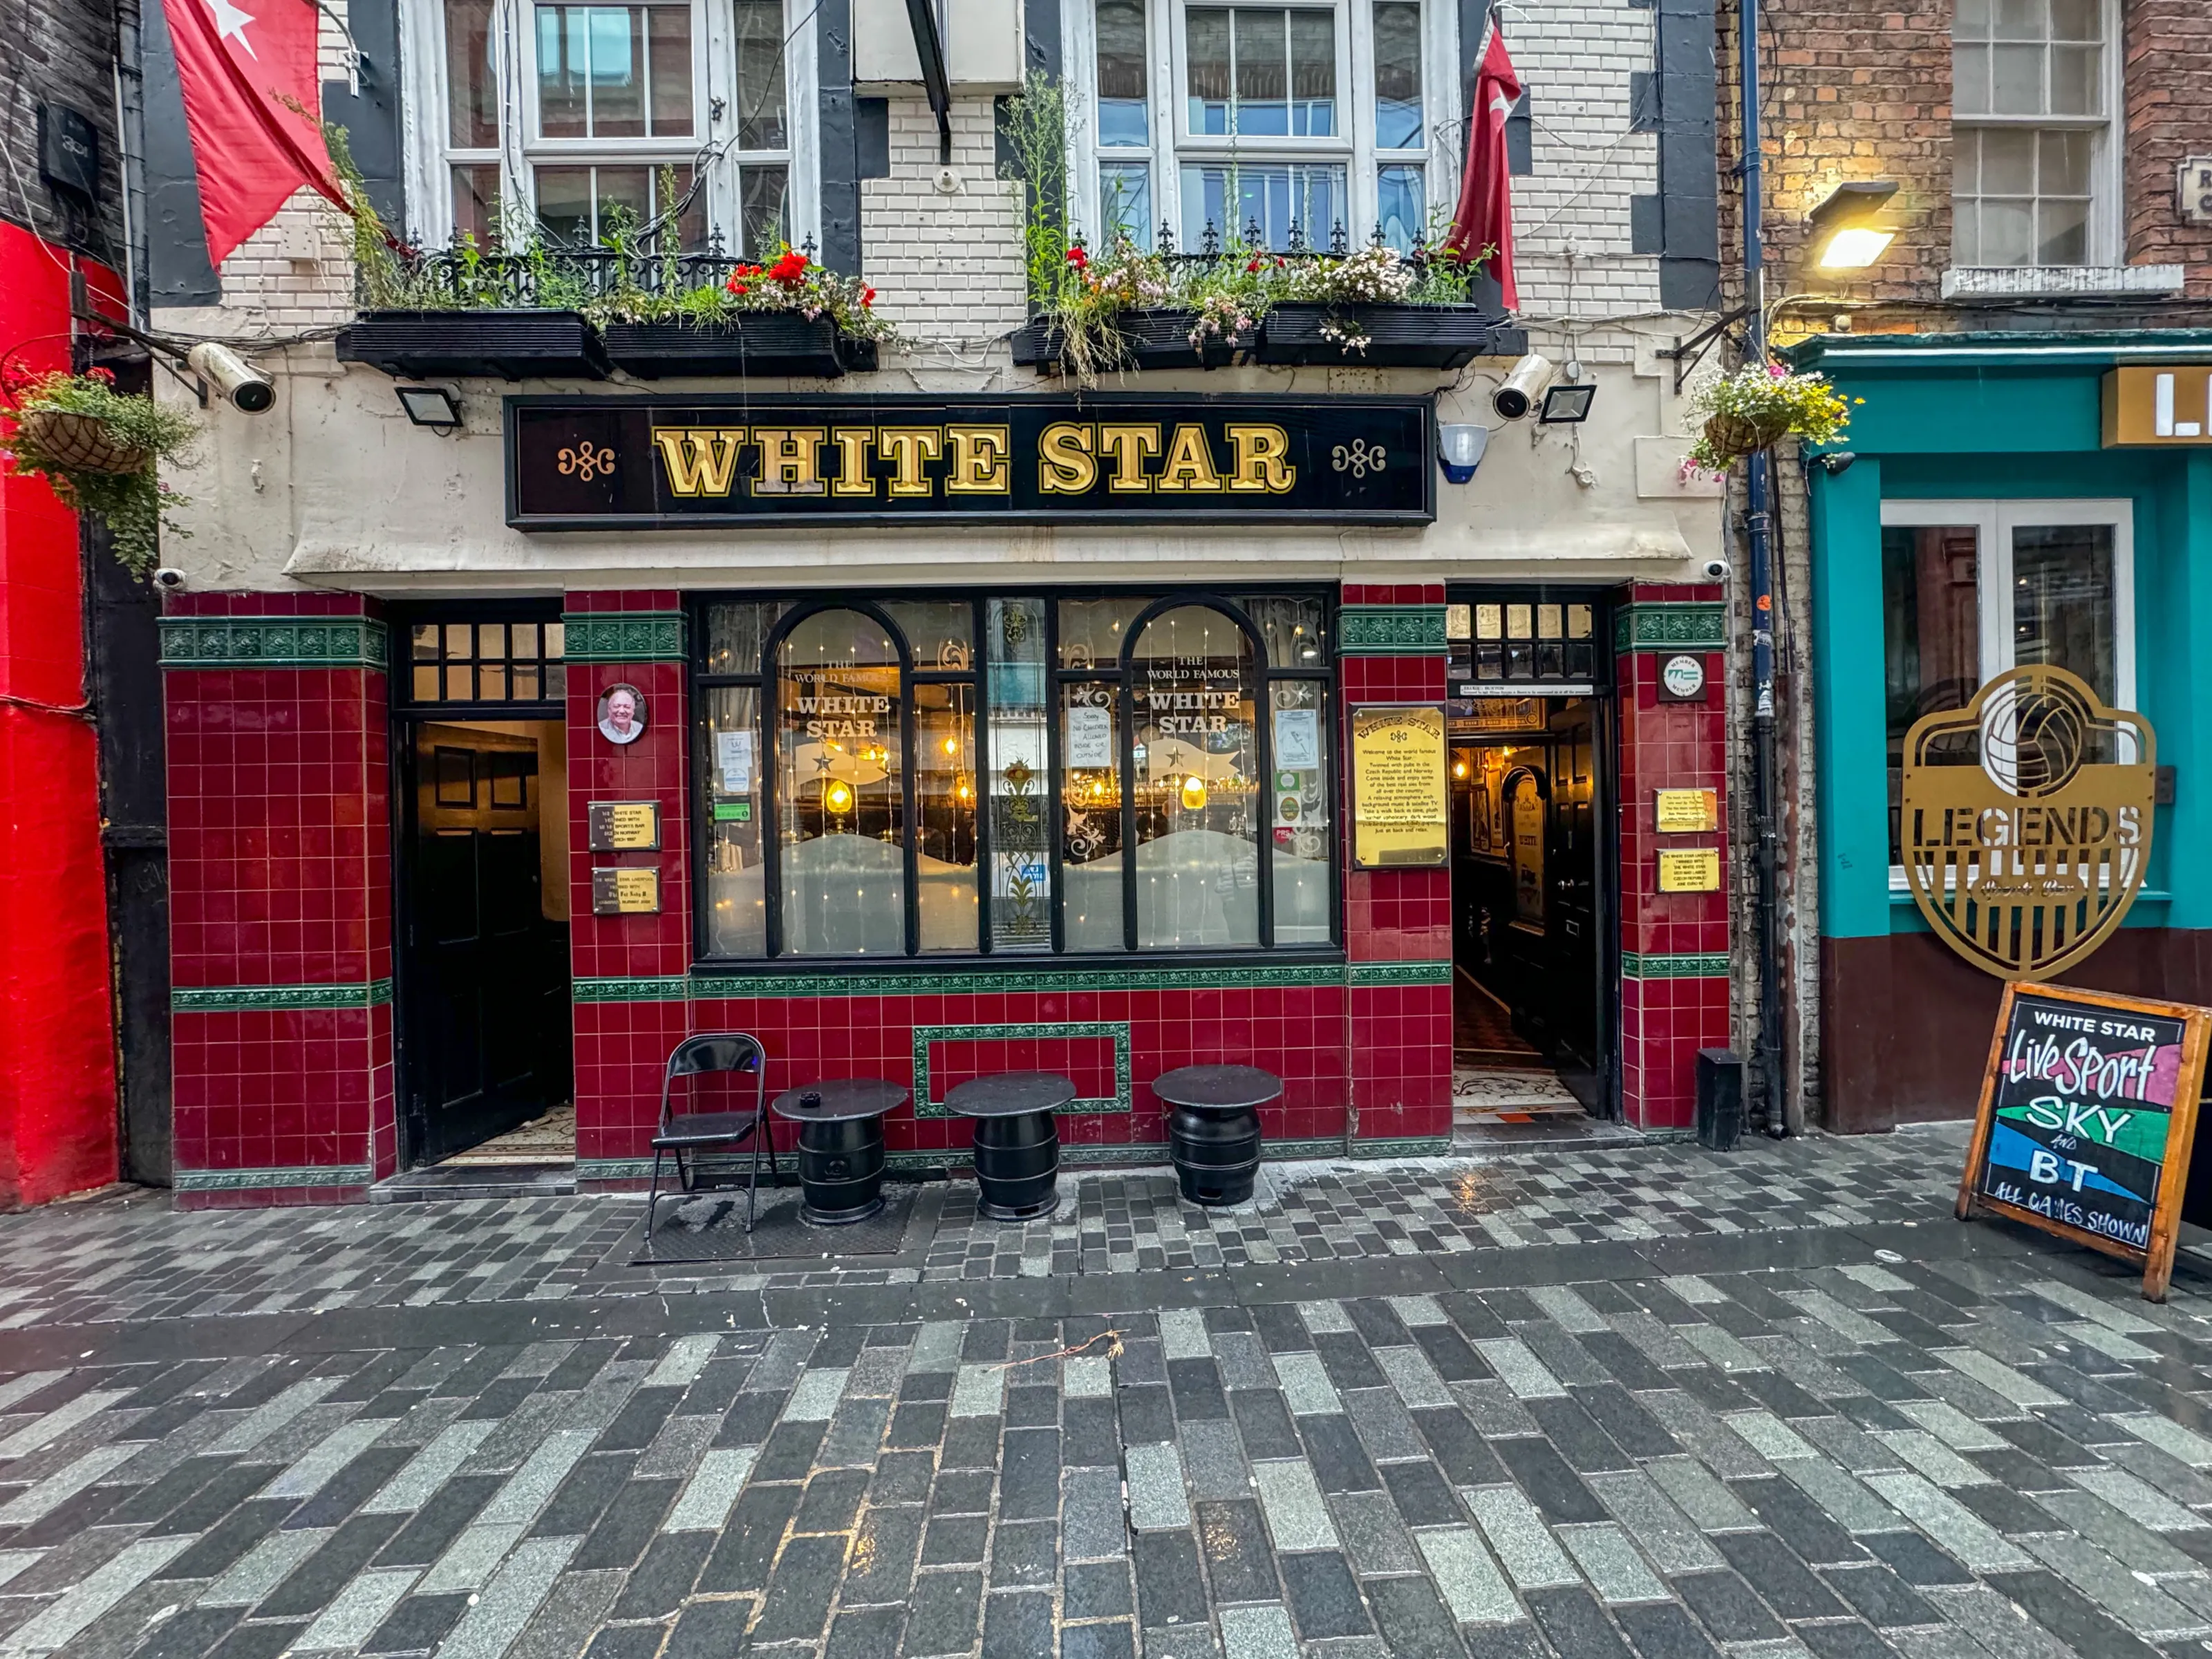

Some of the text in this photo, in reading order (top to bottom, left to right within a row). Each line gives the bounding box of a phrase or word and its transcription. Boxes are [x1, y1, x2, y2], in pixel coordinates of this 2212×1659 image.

[651, 422, 1297, 497] WHITE STAR
[826, 660, 853, 669] THE
[1178, 657, 1203, 666] THE
[1671, 659, 1696, 668] MEMBER
[795, 674, 838, 683] WORLD
[1147, 669, 1239, 679] WORLD FAMOUS
[1672, 684, 1696, 693] MEMBER
[796, 696, 889, 714] WHITE
[1147, 692, 1240, 710] WHITE
[807, 720, 877, 738] STAR
[1159, 715, 1228, 734] STAR
[1357, 716, 1441, 740] WHITE STAR
[1913, 806, 2143, 846] LEGENDS
[2034, 1011, 2156, 1042] WHITE STAR
[2009, 1029, 2060, 1084] Live
[2026, 1096, 2132, 1144] SKY
[2050, 1134, 2077, 1150] AND
[2030, 1150, 2099, 1192] BT
[1994, 1181, 2023, 1201] ALL
[2088, 1211, 2146, 1244] SHOWN
